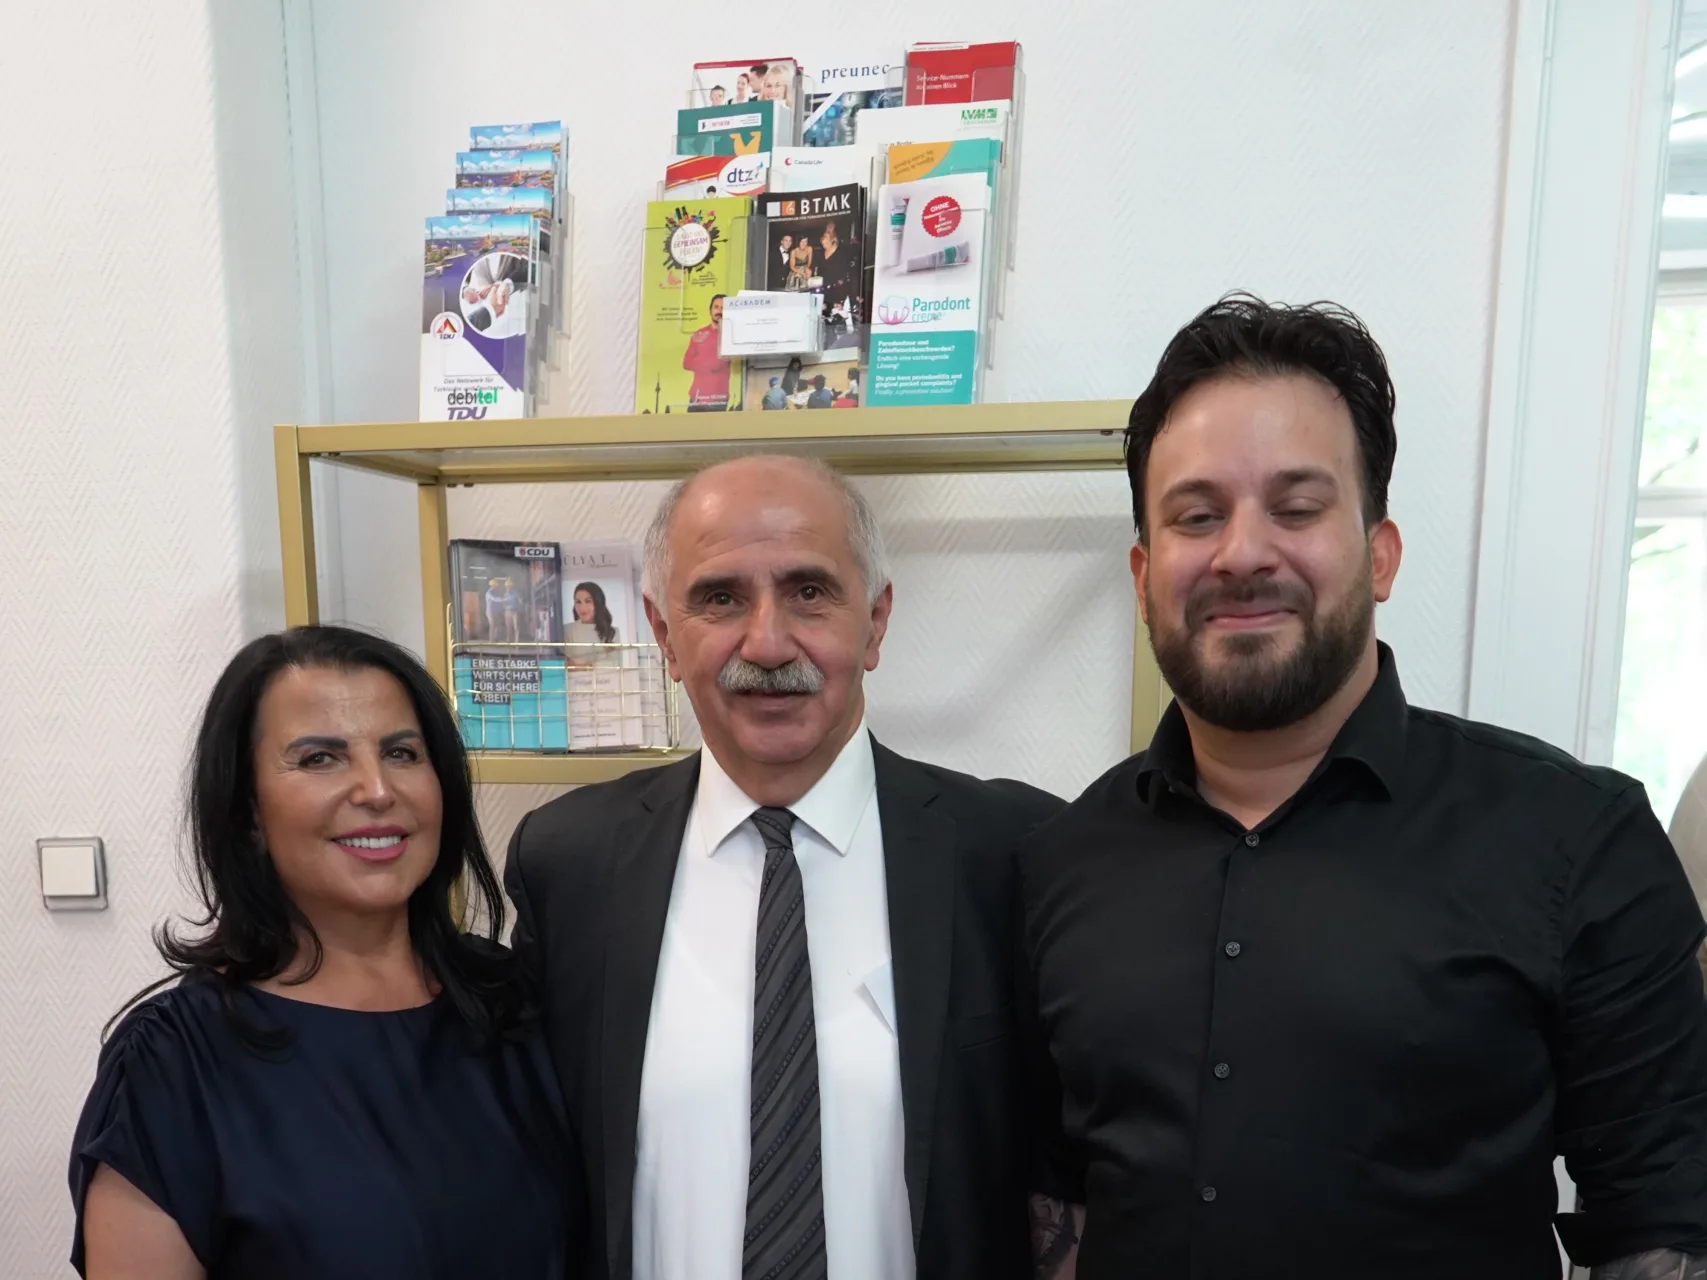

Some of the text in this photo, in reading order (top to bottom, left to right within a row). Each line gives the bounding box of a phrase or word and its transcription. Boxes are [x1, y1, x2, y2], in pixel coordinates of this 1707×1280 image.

[800, 193, 851, 215] BTMK
[930, 201, 950, 213] OHNE
[673, 237, 707, 248] GEMEINSAM
[912, 296, 970, 312] Parodont
[447, 386, 498, 405] debitel
[447, 406, 487, 420] TDU
[527, 548, 550, 556] CDU
[473, 658, 536, 668] EINE STARKE
[473, 670, 539, 680] WIRTSCHAFT
[496, 682, 539, 692] SICHERE
